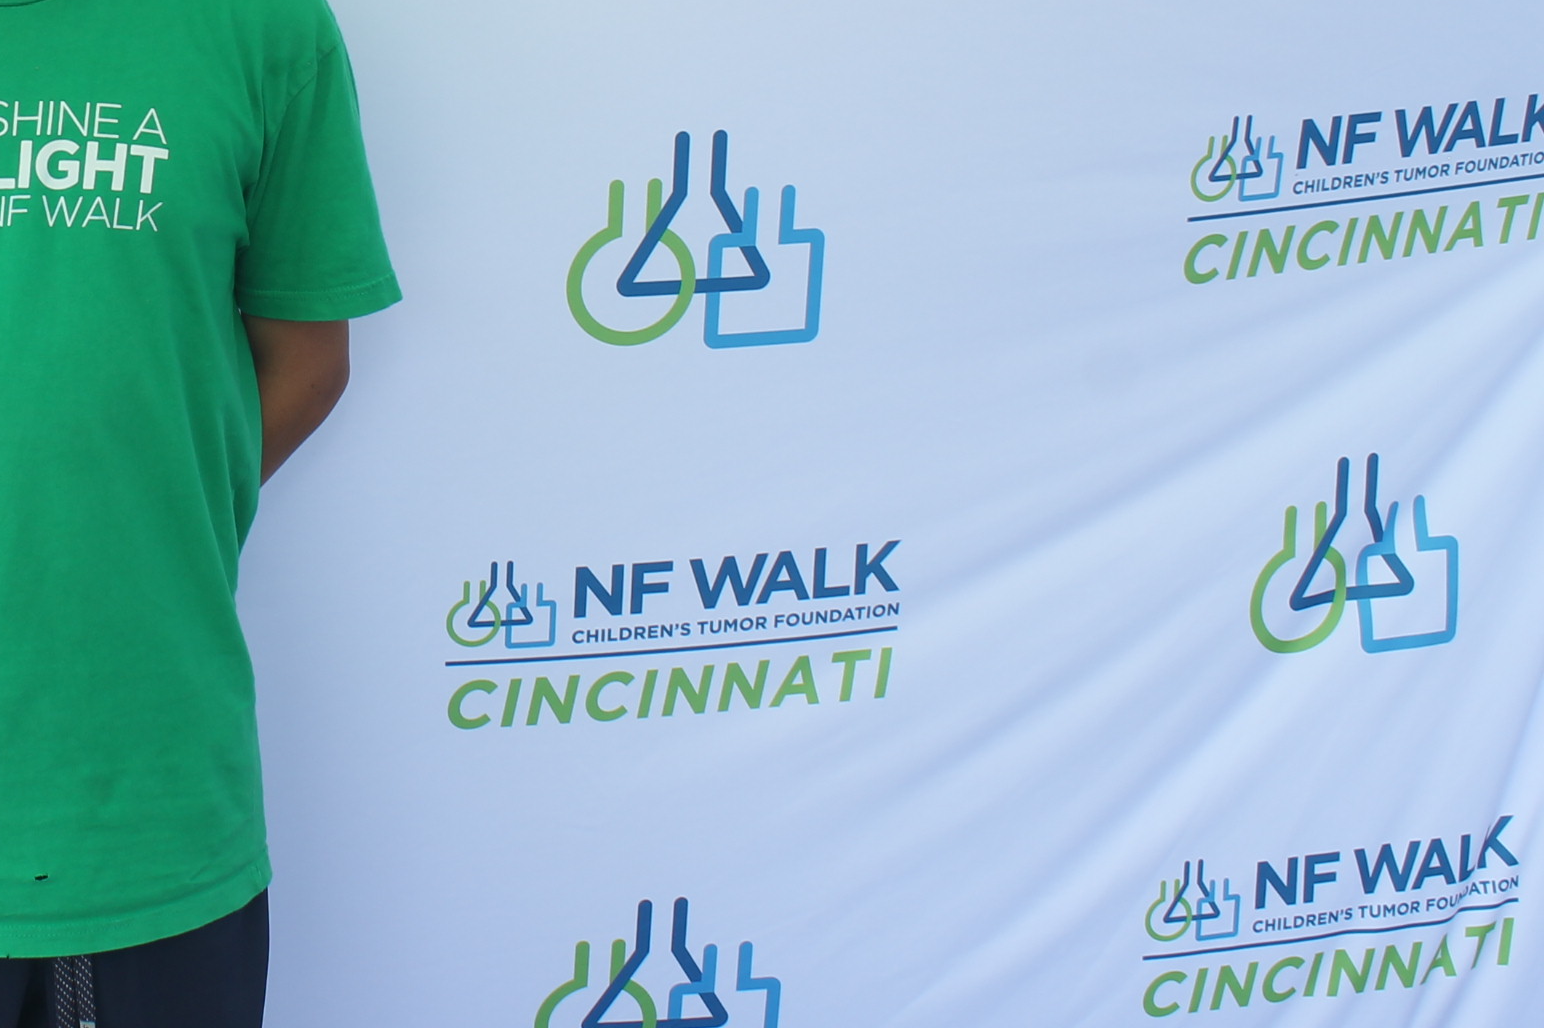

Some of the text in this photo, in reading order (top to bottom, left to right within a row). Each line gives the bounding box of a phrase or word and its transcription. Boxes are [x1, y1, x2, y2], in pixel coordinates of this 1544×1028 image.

[133, 108, 167, 145] A
[1296, 111, 1382, 170] NF
[1292, 171, 1389, 195] CHILDREN'S
[1394, 163, 1449, 183] TUMOR
[42, 195, 163, 232] WALK
[1183, 192, 1544, 285] CINCINNATI
[573, 539, 902, 618] NF WALK
[571, 602, 901, 645] CHILDREN'S TUMOR FOUNDATION
[447, 647, 893, 730] CINCINNATI
[1255, 815, 1519, 910] NF WALK
[1252, 907, 1353, 934] CHILDREN'S
[1358, 900, 1421, 920] TUMOR
[1143, 917, 1515, 1018] CINCINNATI
